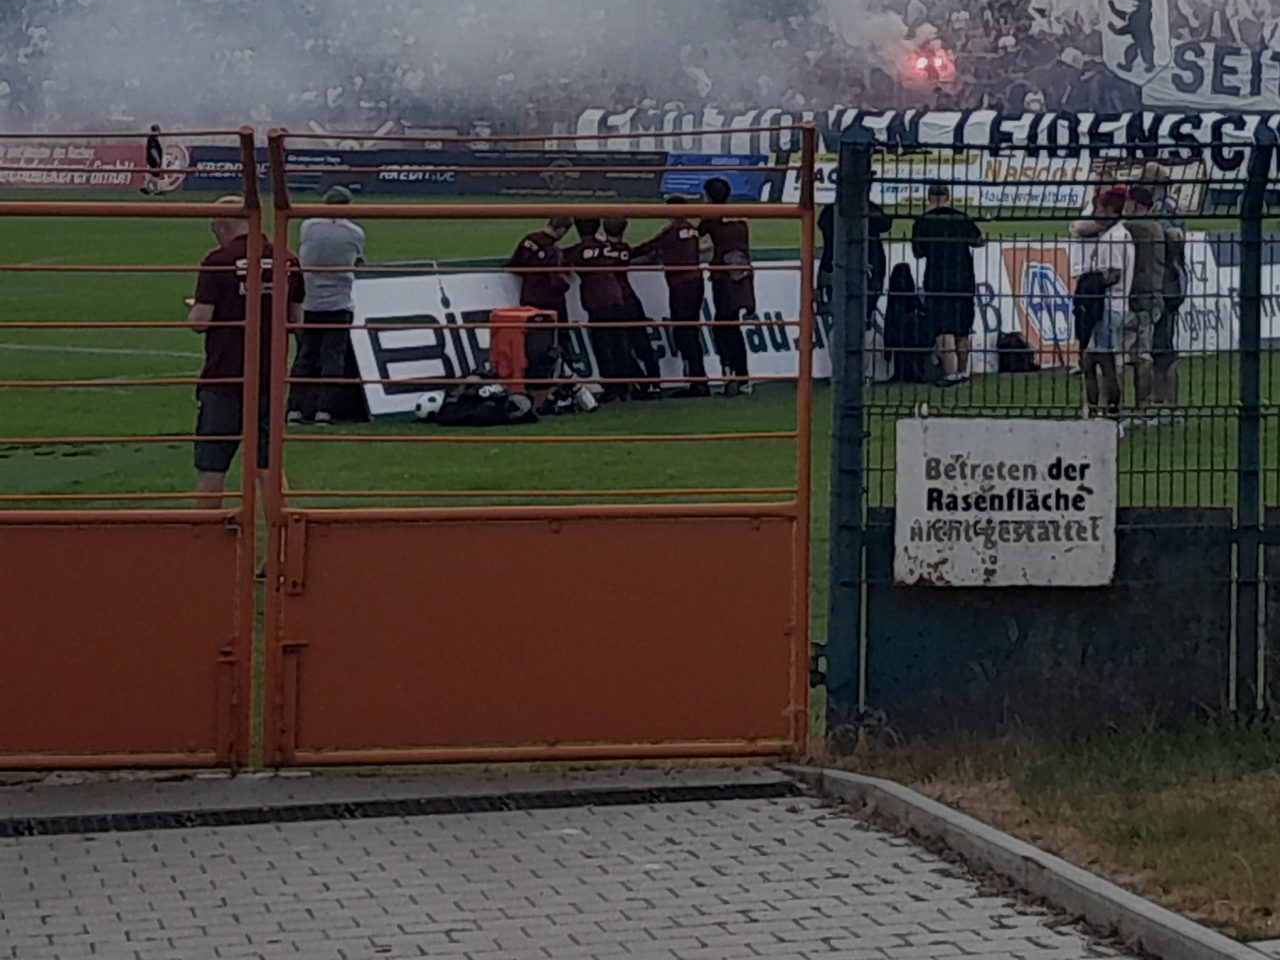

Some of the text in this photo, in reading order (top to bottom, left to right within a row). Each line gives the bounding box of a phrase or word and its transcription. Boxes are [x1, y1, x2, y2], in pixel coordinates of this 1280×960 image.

[924, 454, 1091, 482] Betreten der
[926, 487, 1087, 513] Rasenfläche
